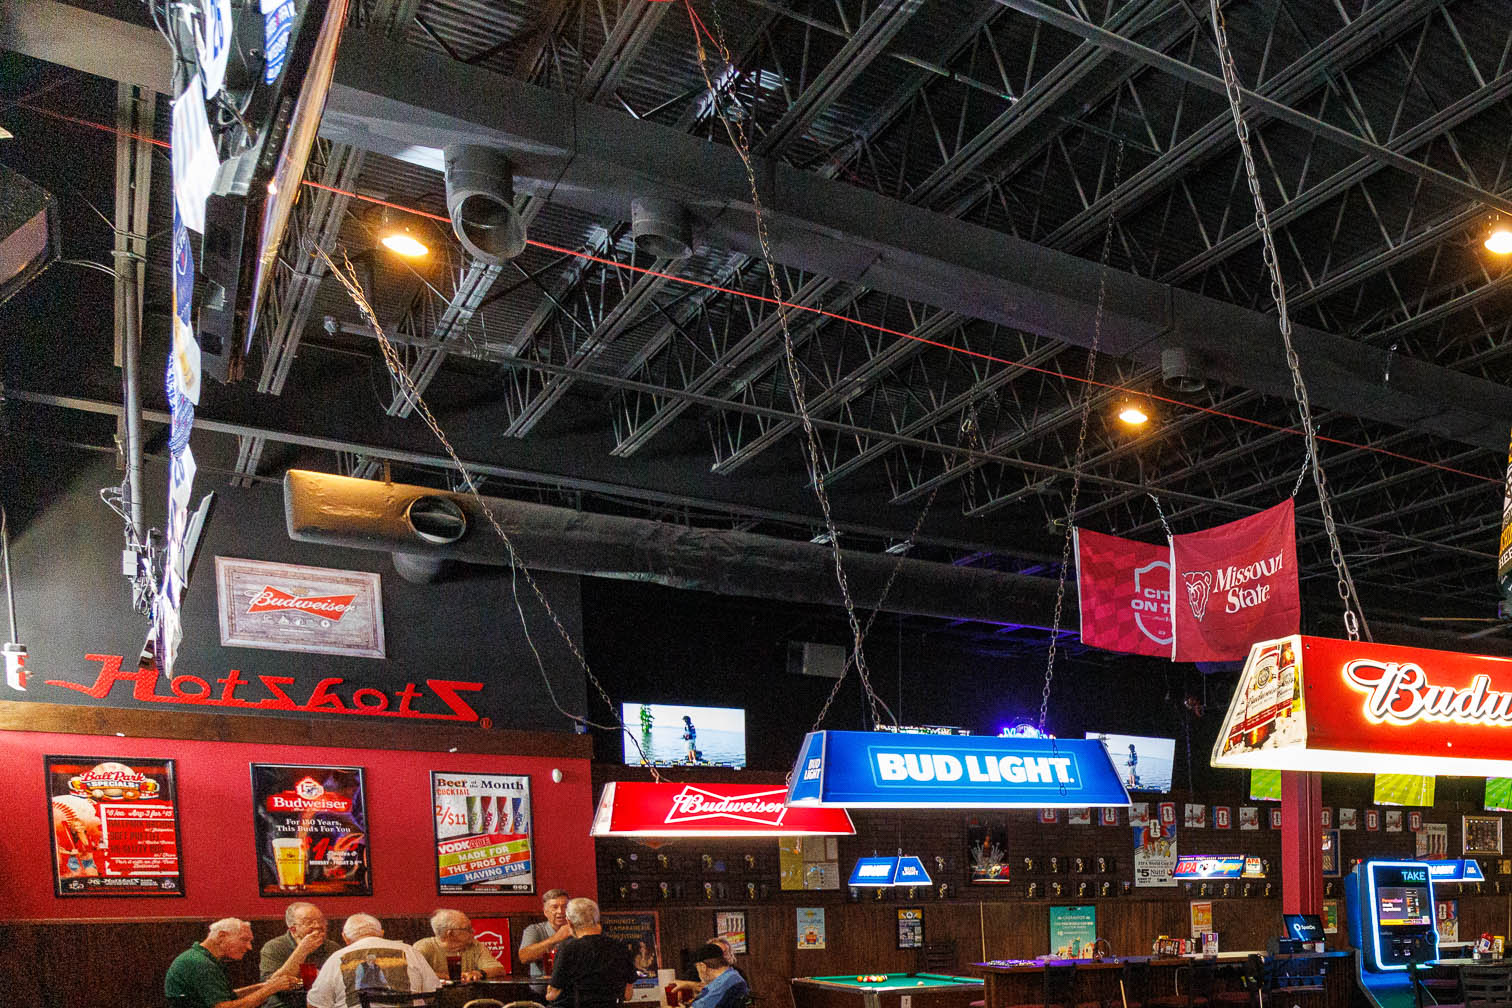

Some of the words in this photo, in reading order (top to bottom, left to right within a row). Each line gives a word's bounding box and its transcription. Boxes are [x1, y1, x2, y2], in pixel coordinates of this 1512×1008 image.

[1144, 588, 1171, 600] CIT
[1226, 583, 1270, 614] State
[244, 588, 355, 621] Budweiser
[1131, 599, 1158, 612] ON
[1161, 603, 1171, 613] T
[807, 758, 821, 769] BUD
[876, 753, 965, 781] BUD
[966, 755, 1071, 783] LIGHT
[804, 768, 821, 780] LIGHT
[437, 778, 467, 788] Beer
[481, 780, 524, 790] Month
[273, 797, 348, 809] Budweiser
[673, 795, 786, 814] Budweiser
[458, 849, 486, 861] MADE
[489, 846, 509, 856] FOR
[448, 864, 468, 874] THE
[470, 859, 496, 870] PROS
[499, 855, 511, 864] OF
[1175, 862, 1198, 873] APA
[465, 867, 502, 881] HAVING
[505, 863, 525, 873] FUN
[1401, 871, 1426, 880] TAKE
